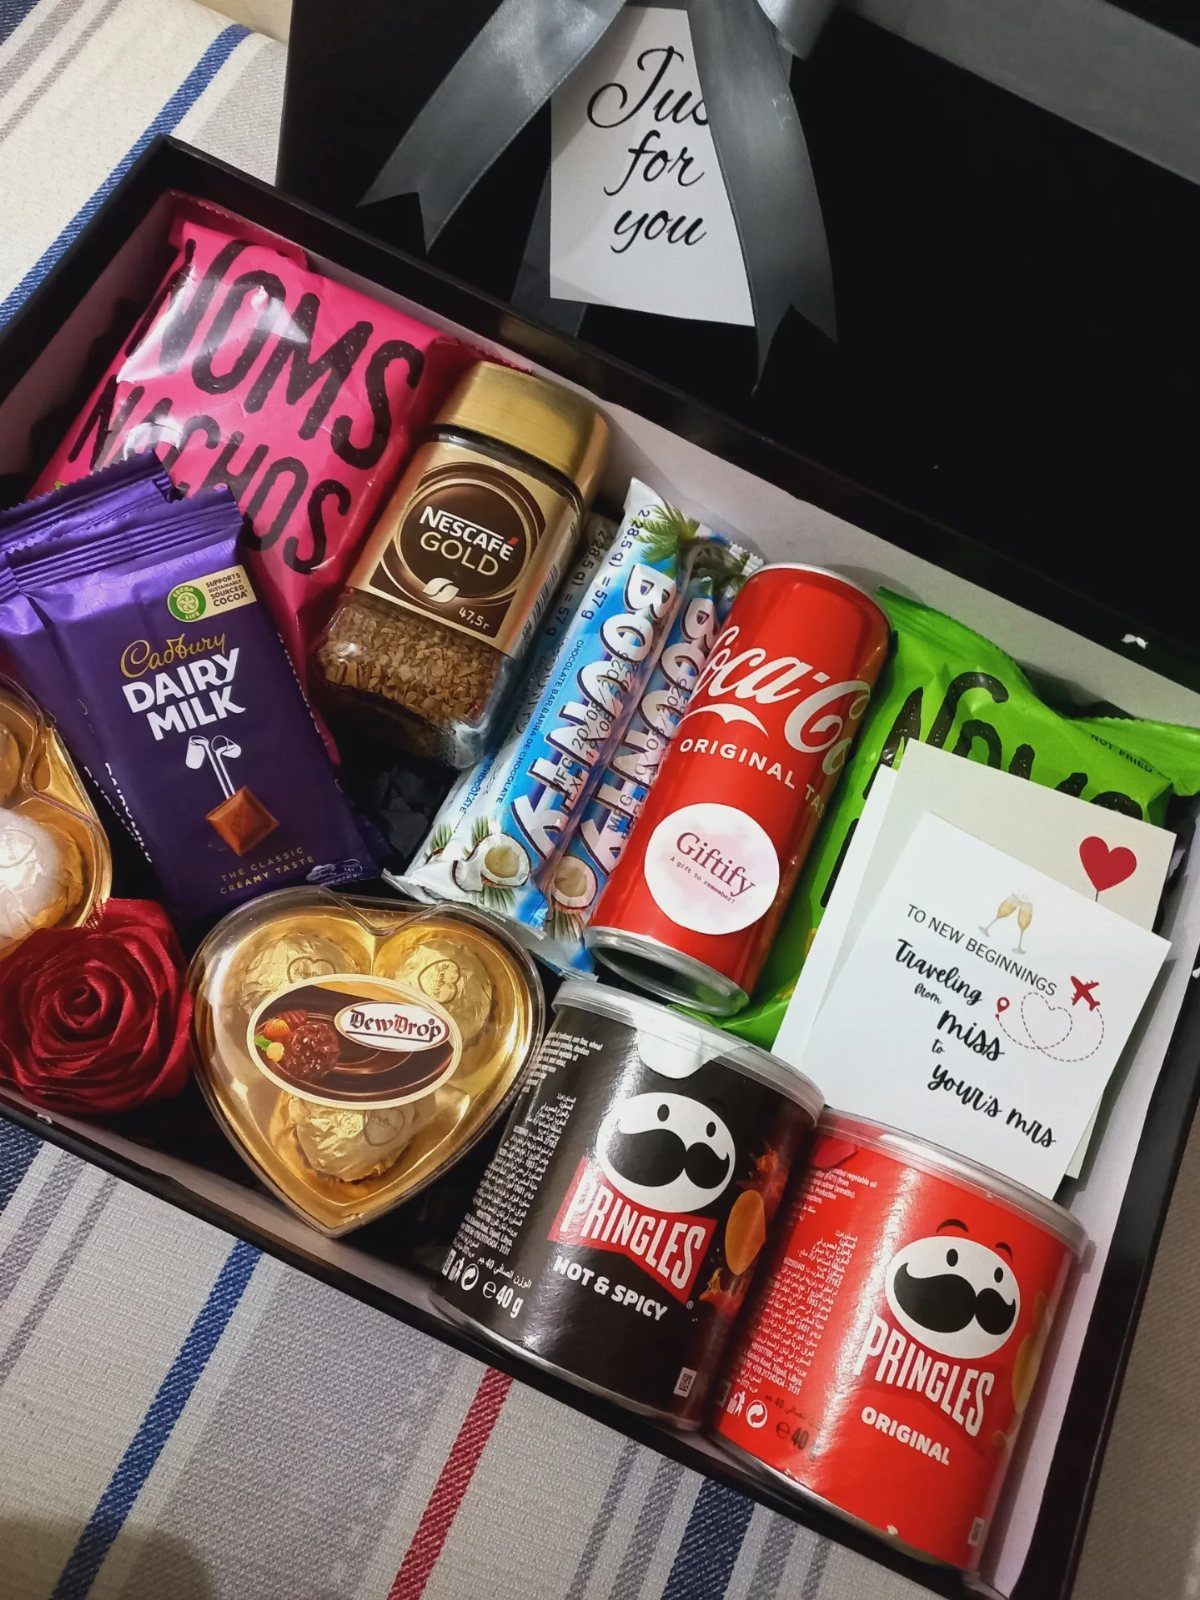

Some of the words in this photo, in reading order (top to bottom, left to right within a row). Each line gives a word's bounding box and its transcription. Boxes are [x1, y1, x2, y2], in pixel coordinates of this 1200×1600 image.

[603, 129, 705, 197] for
[610, 209, 707, 254] you
[420, 531, 499, 576] GOLD
[205, 572, 241, 588] SUPPORTS
[210, 585, 245, 600] SOURCED
[591, 589, 608, 609] 57
[120, 632, 226, 679] Cadbury
[556, 639, 585, 688] CHOCOLATE
[121, 647, 240, 714] DAIRY
[146, 685, 247, 741] MILK
[680, 738, 796, 790] ORIGINAL
[1090, 734, 1114, 750] NOT
[1118, 748, 1153, 773] FRIED
[495, 752, 526, 804] CHOCOLATE
[219, 871, 270, 895] CREAMY
[275, 855, 315, 874] TASTE
[220, 868, 245, 882] THE
[250, 846, 304, 871] CLASSIC
[676, 831, 757, 898] Giftify
[676, 861, 692, 874] gift
[694, 873, 702, 881] to
[894, 937, 983, 1006] Traveling
[907, 903, 927, 923] TO
[928, 916, 965, 944] NEW
[965, 937, 1058, 997] BEGINNINGS
[914, 983, 943, 1004] from
[350, 1009, 442, 1042] DewDrop
[931, 1038, 946, 1055] to
[936, 1009, 1005, 1061] miss
[1005, 1107, 1057, 1148] mrs
[559, 1170, 706, 1290] PRINGLES
[553, 1255, 595, 1287] HOT
[593, 1276, 610, 1296] &
[611, 1284, 668, 1321] SPICY
[853, 1314, 995, 1438] PRINGLES
[861, 1406, 950, 1466] ORIGINAL
